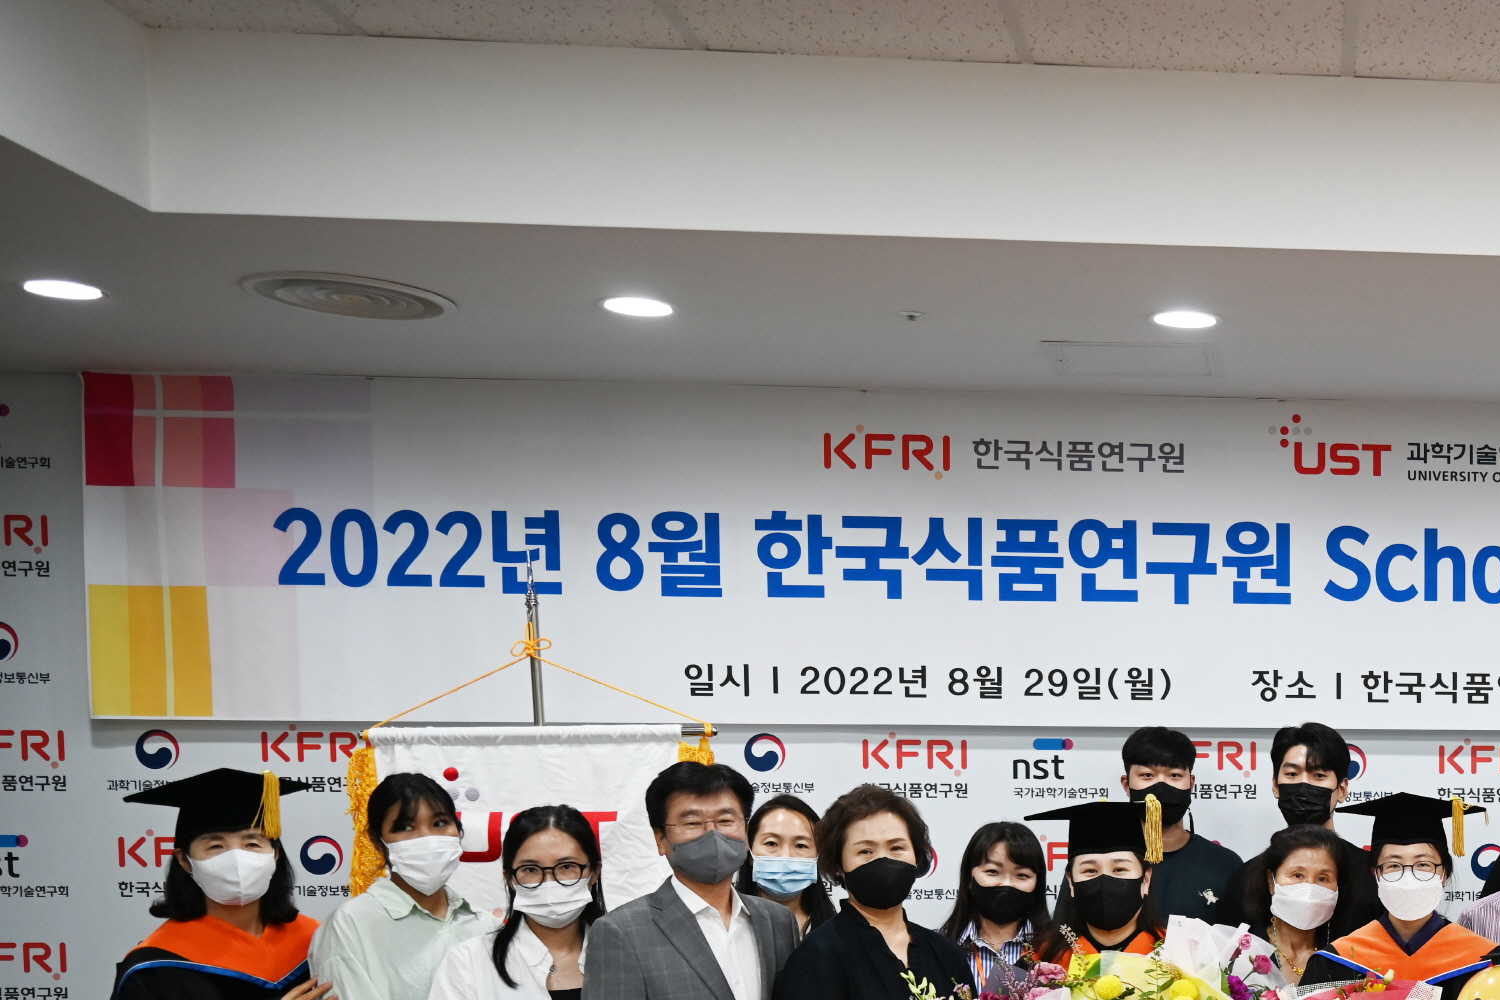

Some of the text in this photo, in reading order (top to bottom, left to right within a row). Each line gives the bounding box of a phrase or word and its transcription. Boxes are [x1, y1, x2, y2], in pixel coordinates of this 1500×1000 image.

[824, 433, 950, 470] KFRI
[972, 438, 1184, 473] 한국식품연구원
[1294, 442, 1392, 476] UST
[1408, 470, 1488, 482] UNIVERSITY
[0, 561, 50, 577] 연구원
[273, 507, 562, 598] 2022년
[596, 511, 722, 597] 8월
[755, 511, 1291, 604] 한국식품연구원
[685, 664, 749, 696] 일시
[801, 666, 926, 698] 2022년
[948, 666, 1002, 699] 8월
[1024, 668, 1171, 700] 29일(월)
[1252, 670, 1316, 702] 장소
[261, 731, 358, 763] KFR
[862, 737, 967, 769] KFRI
[2, 775, 66, 791] 품연구원
[1013, 755, 1064, 779] nst
[1014, 788, 1108, 798] 국가과학기술연구회
[0, 885, 68, 897] 학기술연구회
